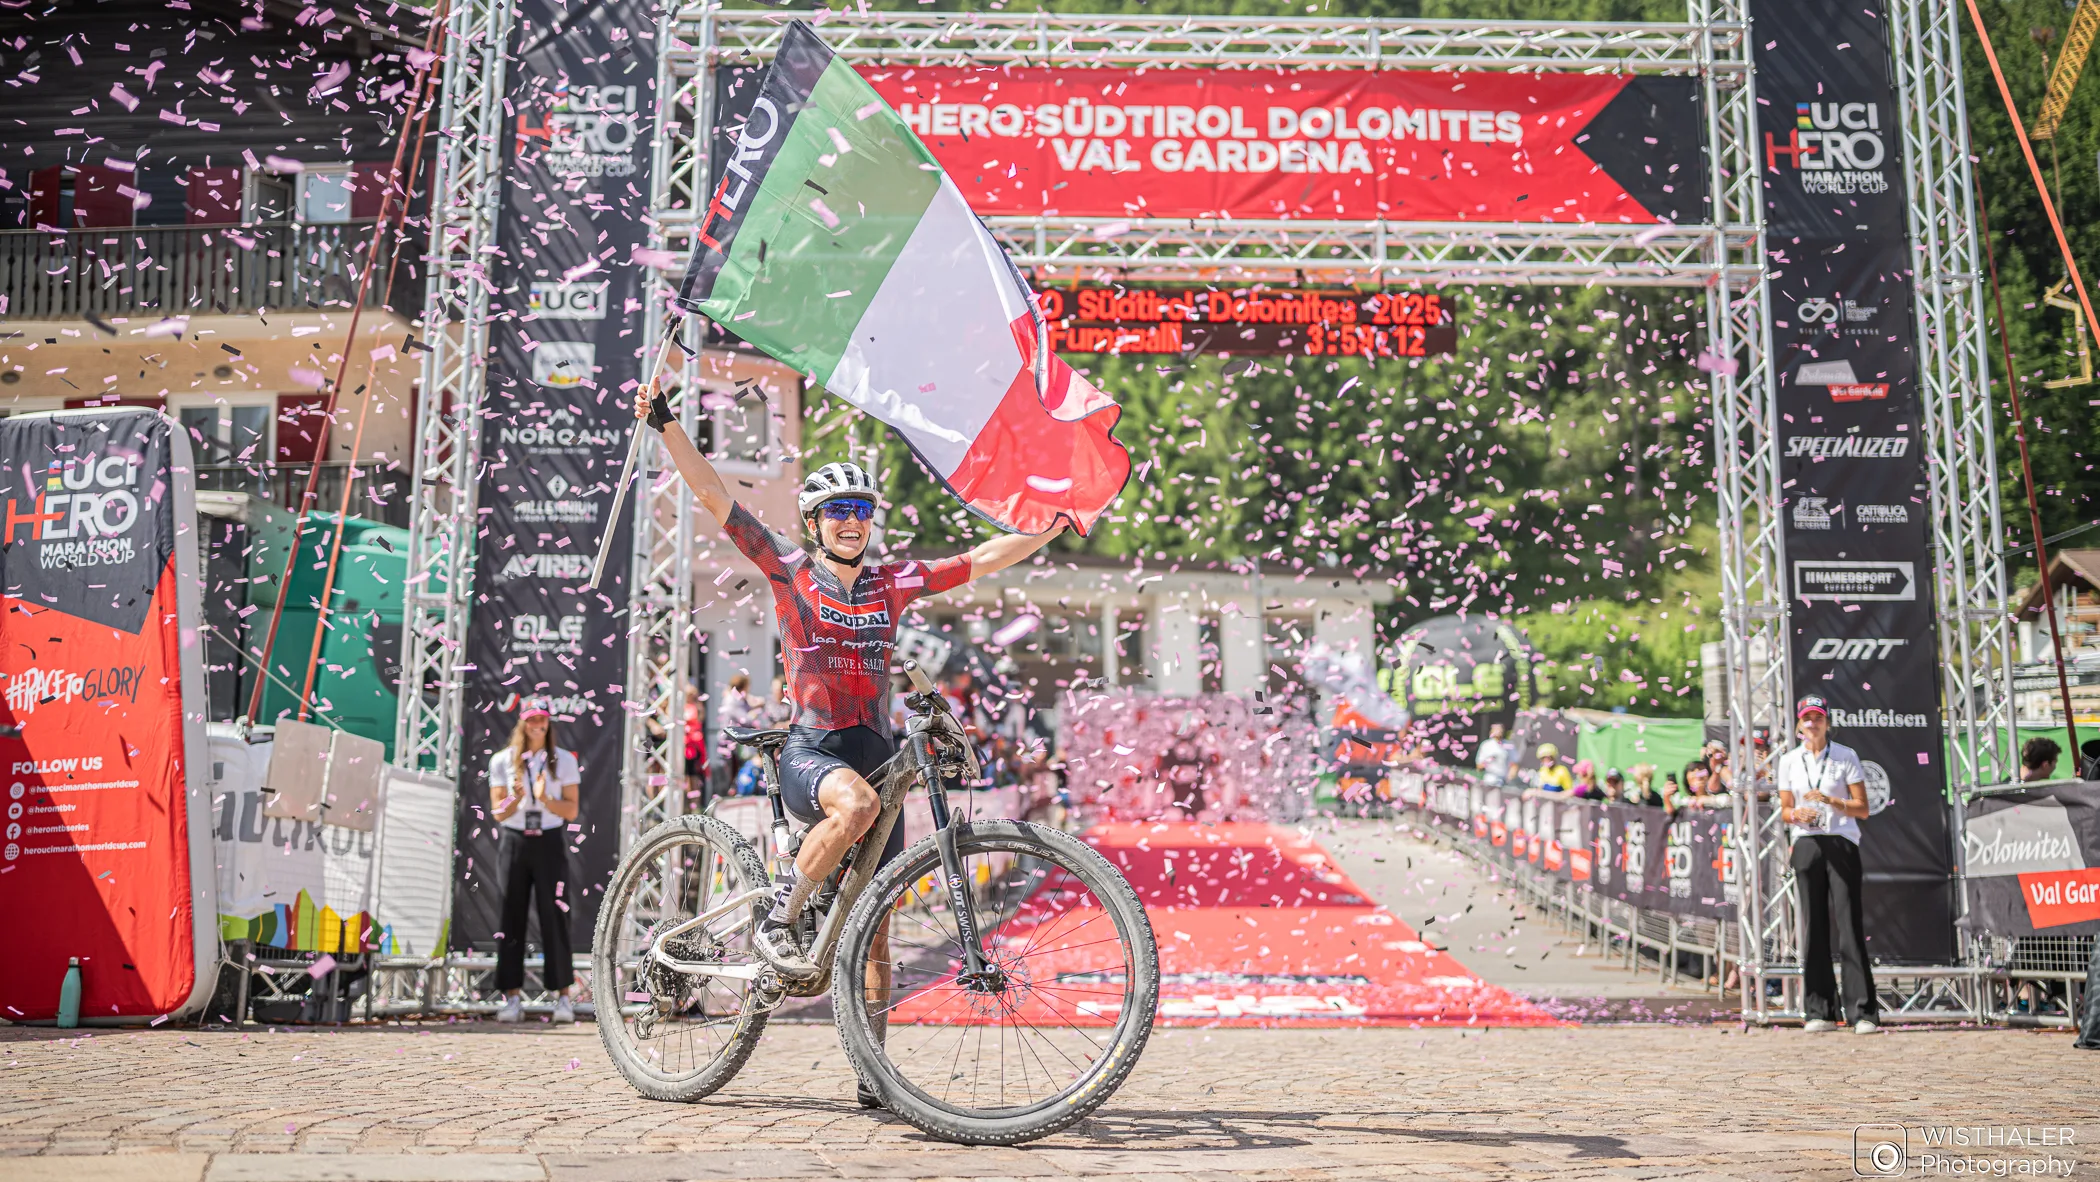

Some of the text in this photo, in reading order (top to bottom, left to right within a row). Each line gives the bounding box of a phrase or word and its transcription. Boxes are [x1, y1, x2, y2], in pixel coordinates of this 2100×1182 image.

[569, 85, 637, 112] UCI
[901, 98, 1523, 143] HERO SÜDTIROL DOLOMITES
[1811, 102, 1879, 129] UCI
[516, 111, 638, 157] HERO
[1052, 139, 1373, 173] VAL GARDENA
[1765, 127, 1884, 172] HERO
[606, 163, 637, 178] CUP
[1801, 171, 1883, 184] MARATHON
[1804, 181, 1888, 194] WORLD CUP
[545, 290, 599, 310] UCI
[1078, 289, 1194, 321] Südtirol
[1208, 291, 1358, 323] Dolomites
[1372, 293, 1441, 325] 2025
[501, 428, 620, 446] NORQAIN
[1784, 436, 1909, 458] SPECIALIZED
[64, 455, 137, 487] UCI
[4, 490, 138, 545] HERO
[40, 537, 131, 558] MARATHON
[40, 549, 135, 569] WORLD CUP
[821, 606, 889, 627] SOUDAL
[1808, 638, 1905, 660] DMT
[828, 656, 856, 669] PIEVE
[1830, 708, 1928, 728] Raiffeisen
[12, 756, 103, 775] FOLLOW US
[24, 840, 147, 855] heroucimarathonworldcup.com
[1007, 841, 1052, 858] URSUS
[1965, 828, 2072, 866] Dolomites
[2030, 880, 2100, 905] Val Gar
[953, 890, 974, 942] DT SWISS
